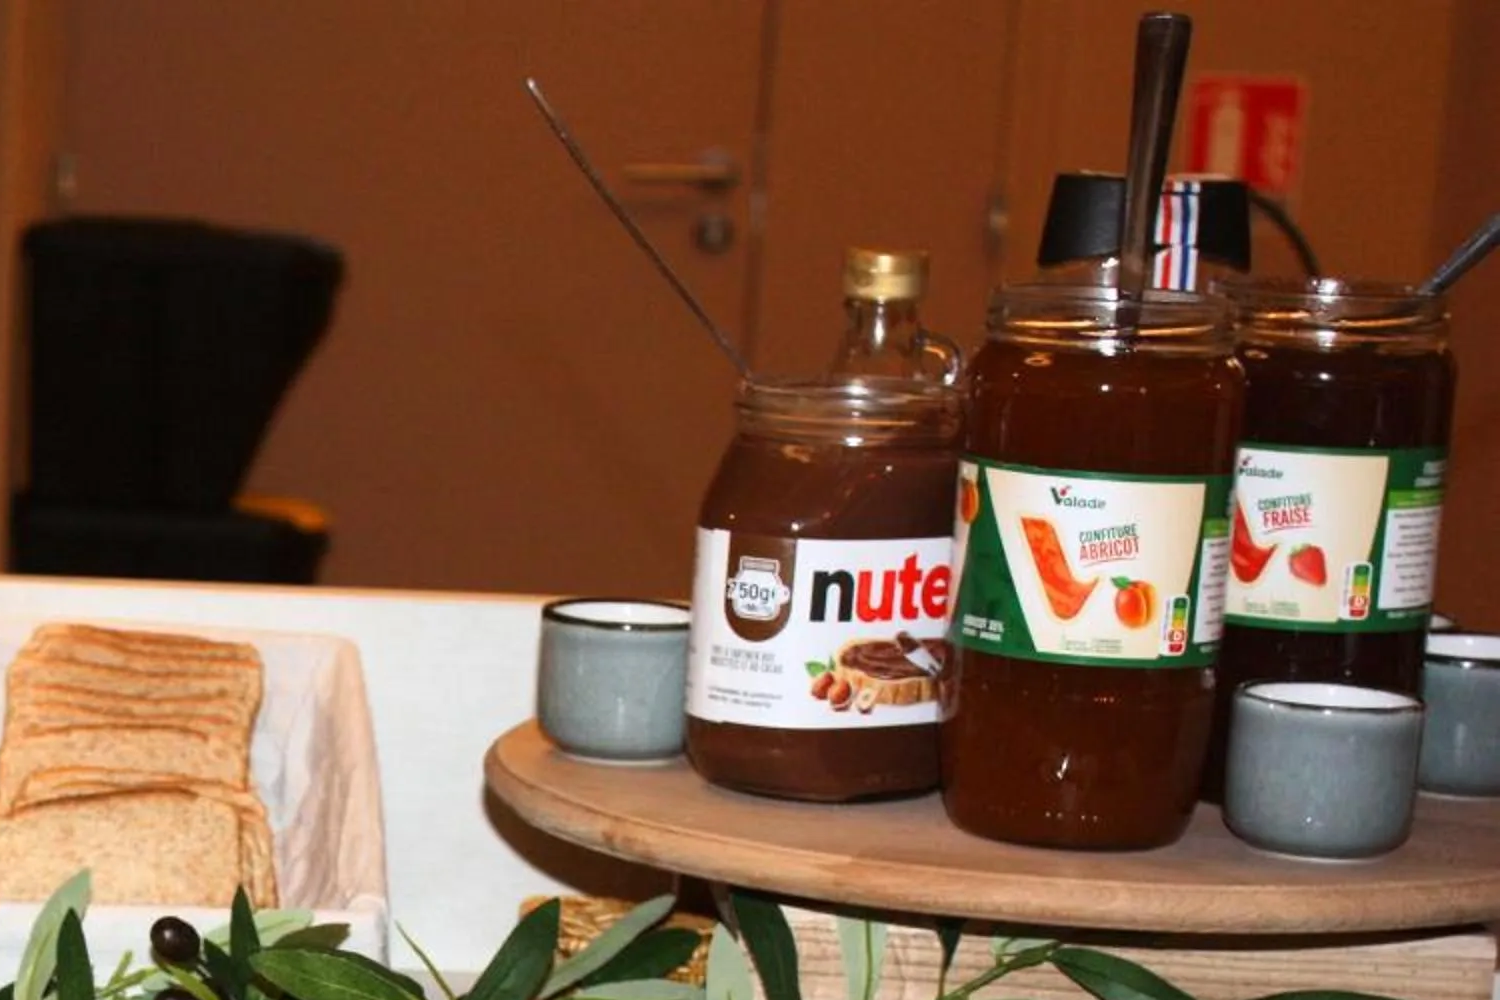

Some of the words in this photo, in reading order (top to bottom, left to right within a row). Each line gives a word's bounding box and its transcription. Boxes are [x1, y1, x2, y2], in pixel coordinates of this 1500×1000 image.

[1238, 465, 1284, 479] alade
[1050, 486, 1107, 510] Valade
[1263, 506, 1312, 529] FRAISE
[1078, 523, 1138, 544] CONFITURE
[1078, 537, 1140, 561] ABRICOT
